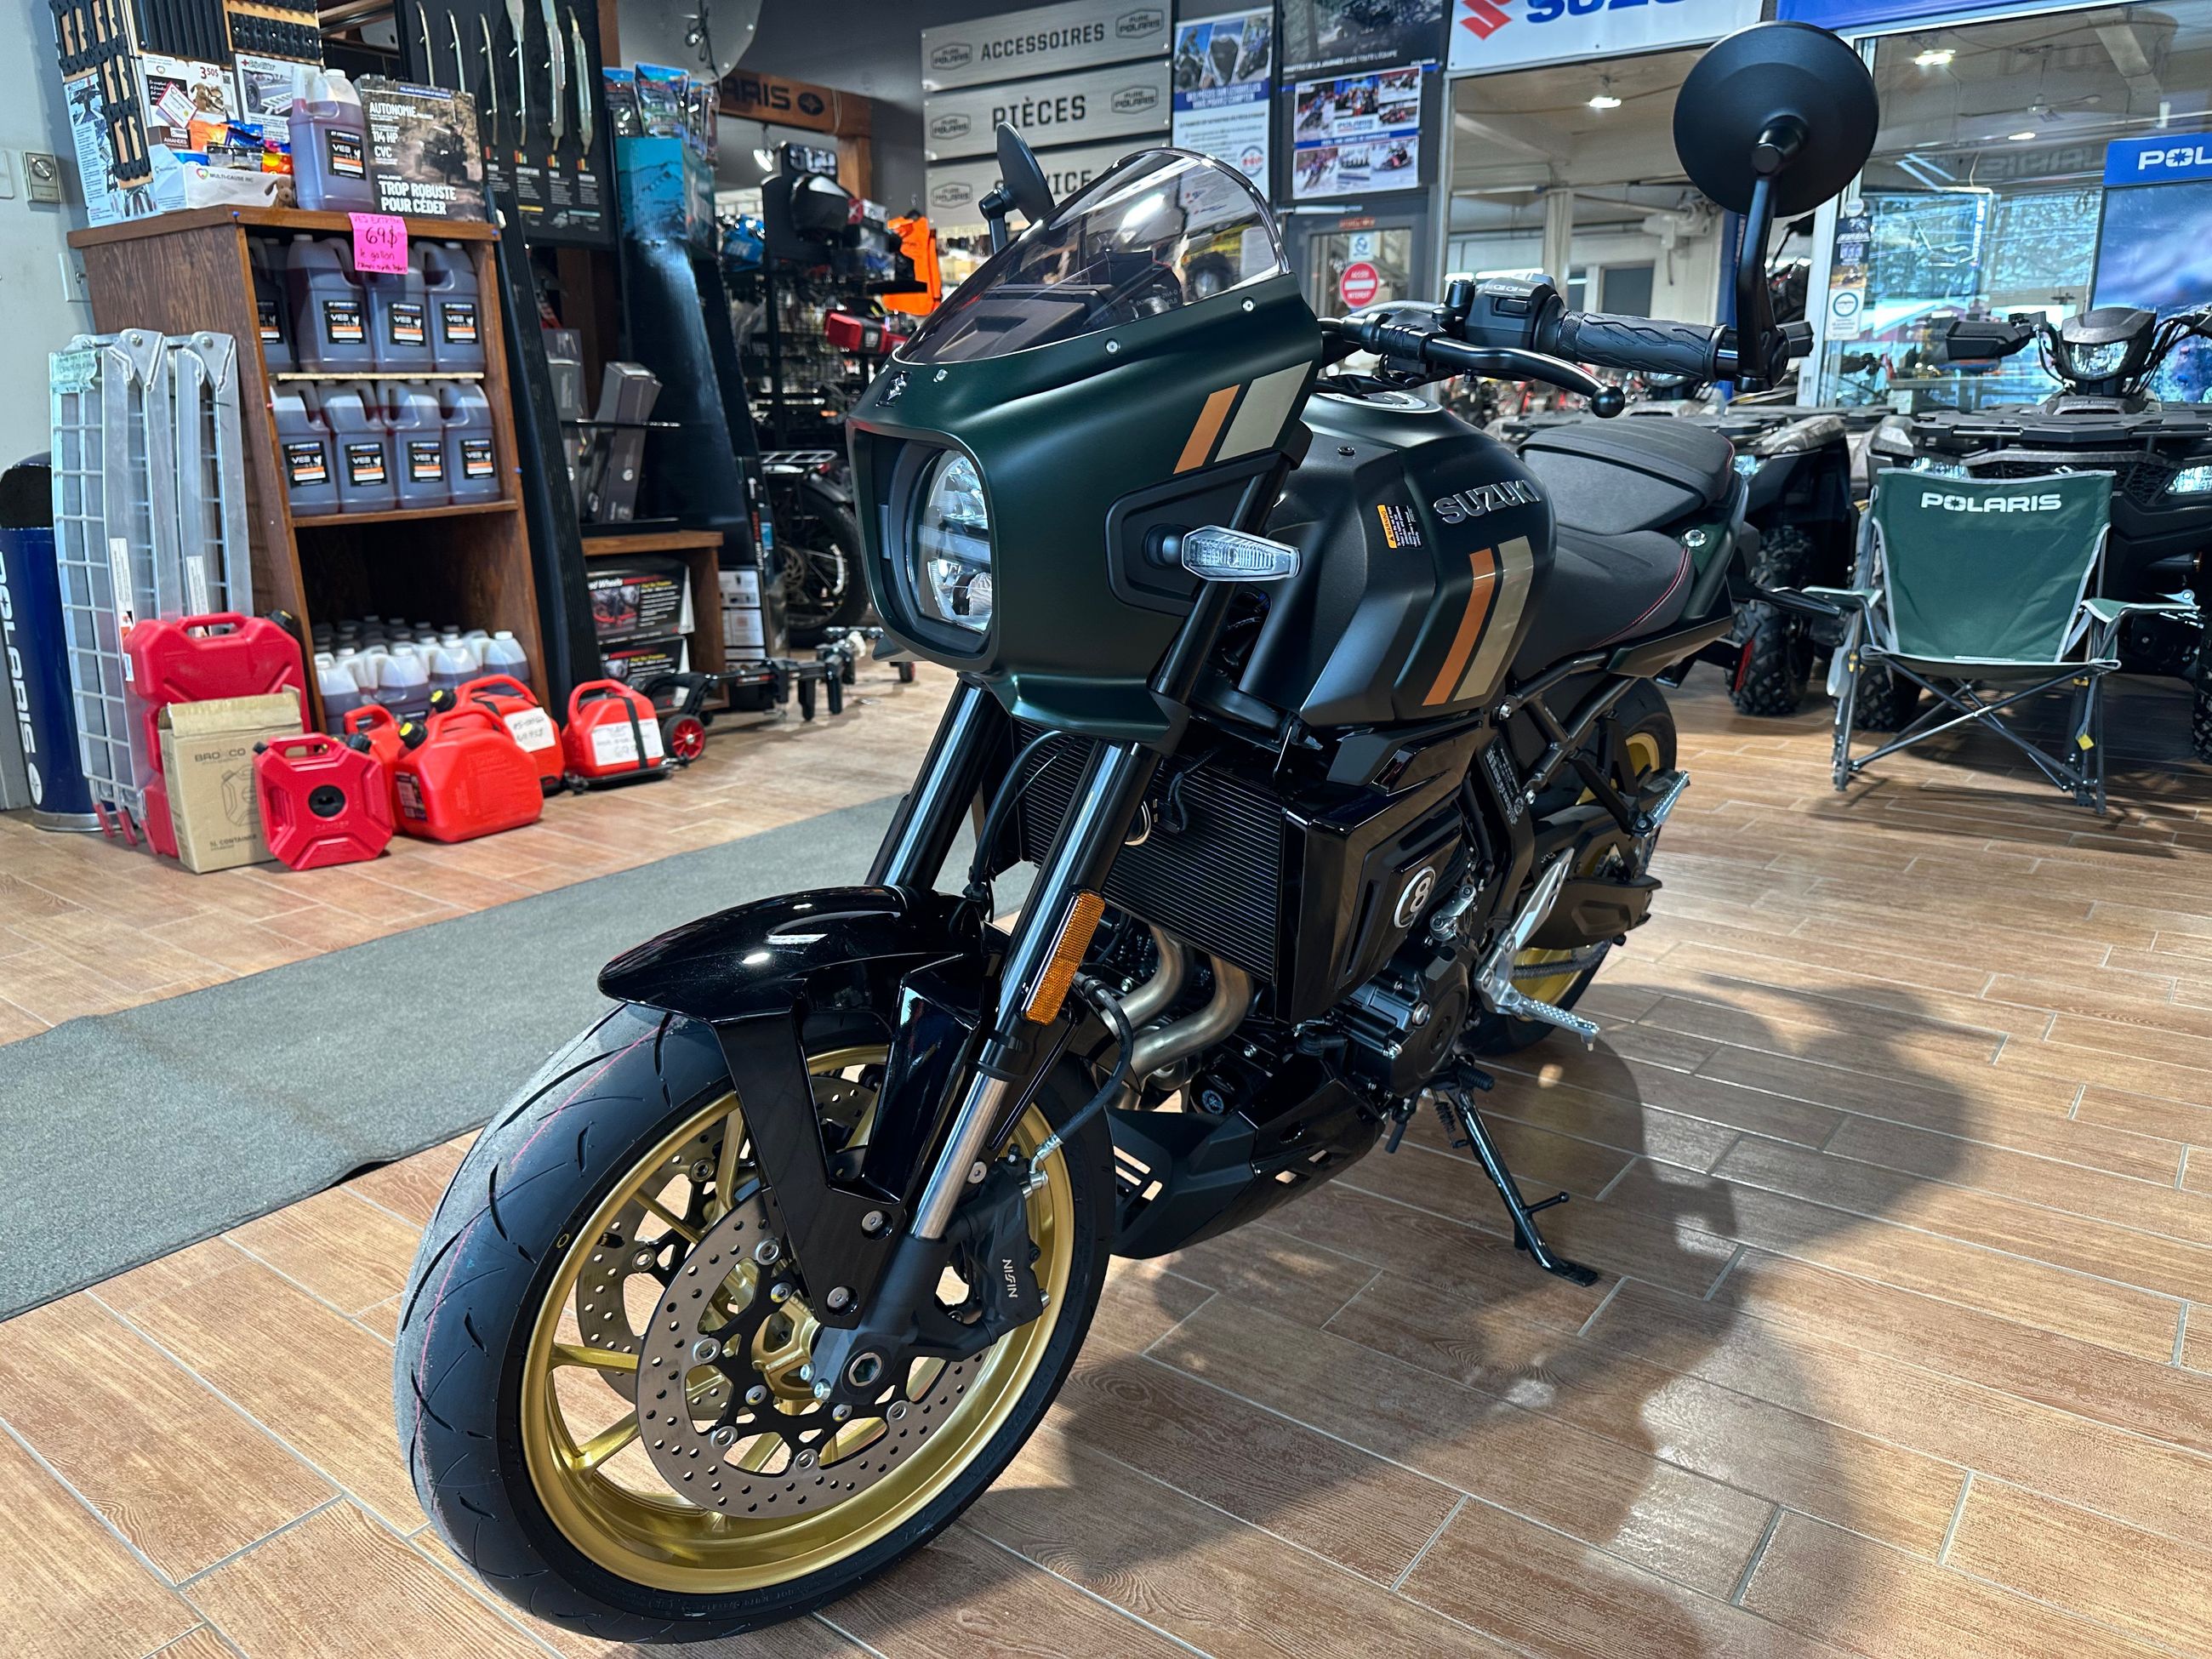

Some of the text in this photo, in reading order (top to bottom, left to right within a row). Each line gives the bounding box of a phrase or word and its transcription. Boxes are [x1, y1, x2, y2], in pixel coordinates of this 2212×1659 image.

[1120, 20, 1160, 33] POLARIS
[981, 23, 1104, 60] ACCESSOIRES
[369, 102, 417, 117] AUTONOMIE
[1115, 95, 1155, 107] POLARIS
[992, 95, 1086, 131] PIÈCES
[372, 131, 385, 142] 114
[386, 132, 398, 144] HP
[374, 145, 392, 158] CVC
[210, 173, 244, 182] MULTI-CAUSE
[379, 180, 457, 201] TROP ROBUSTE
[381, 195, 447, 215] POUR CÉDER
[1434, 480, 1542, 524] SUZUKI
[1921, 492, 2062, 512] POLARIS
[1381, 510, 1393, 536] WARNING
[1410, 877, 1431, 913] 8
